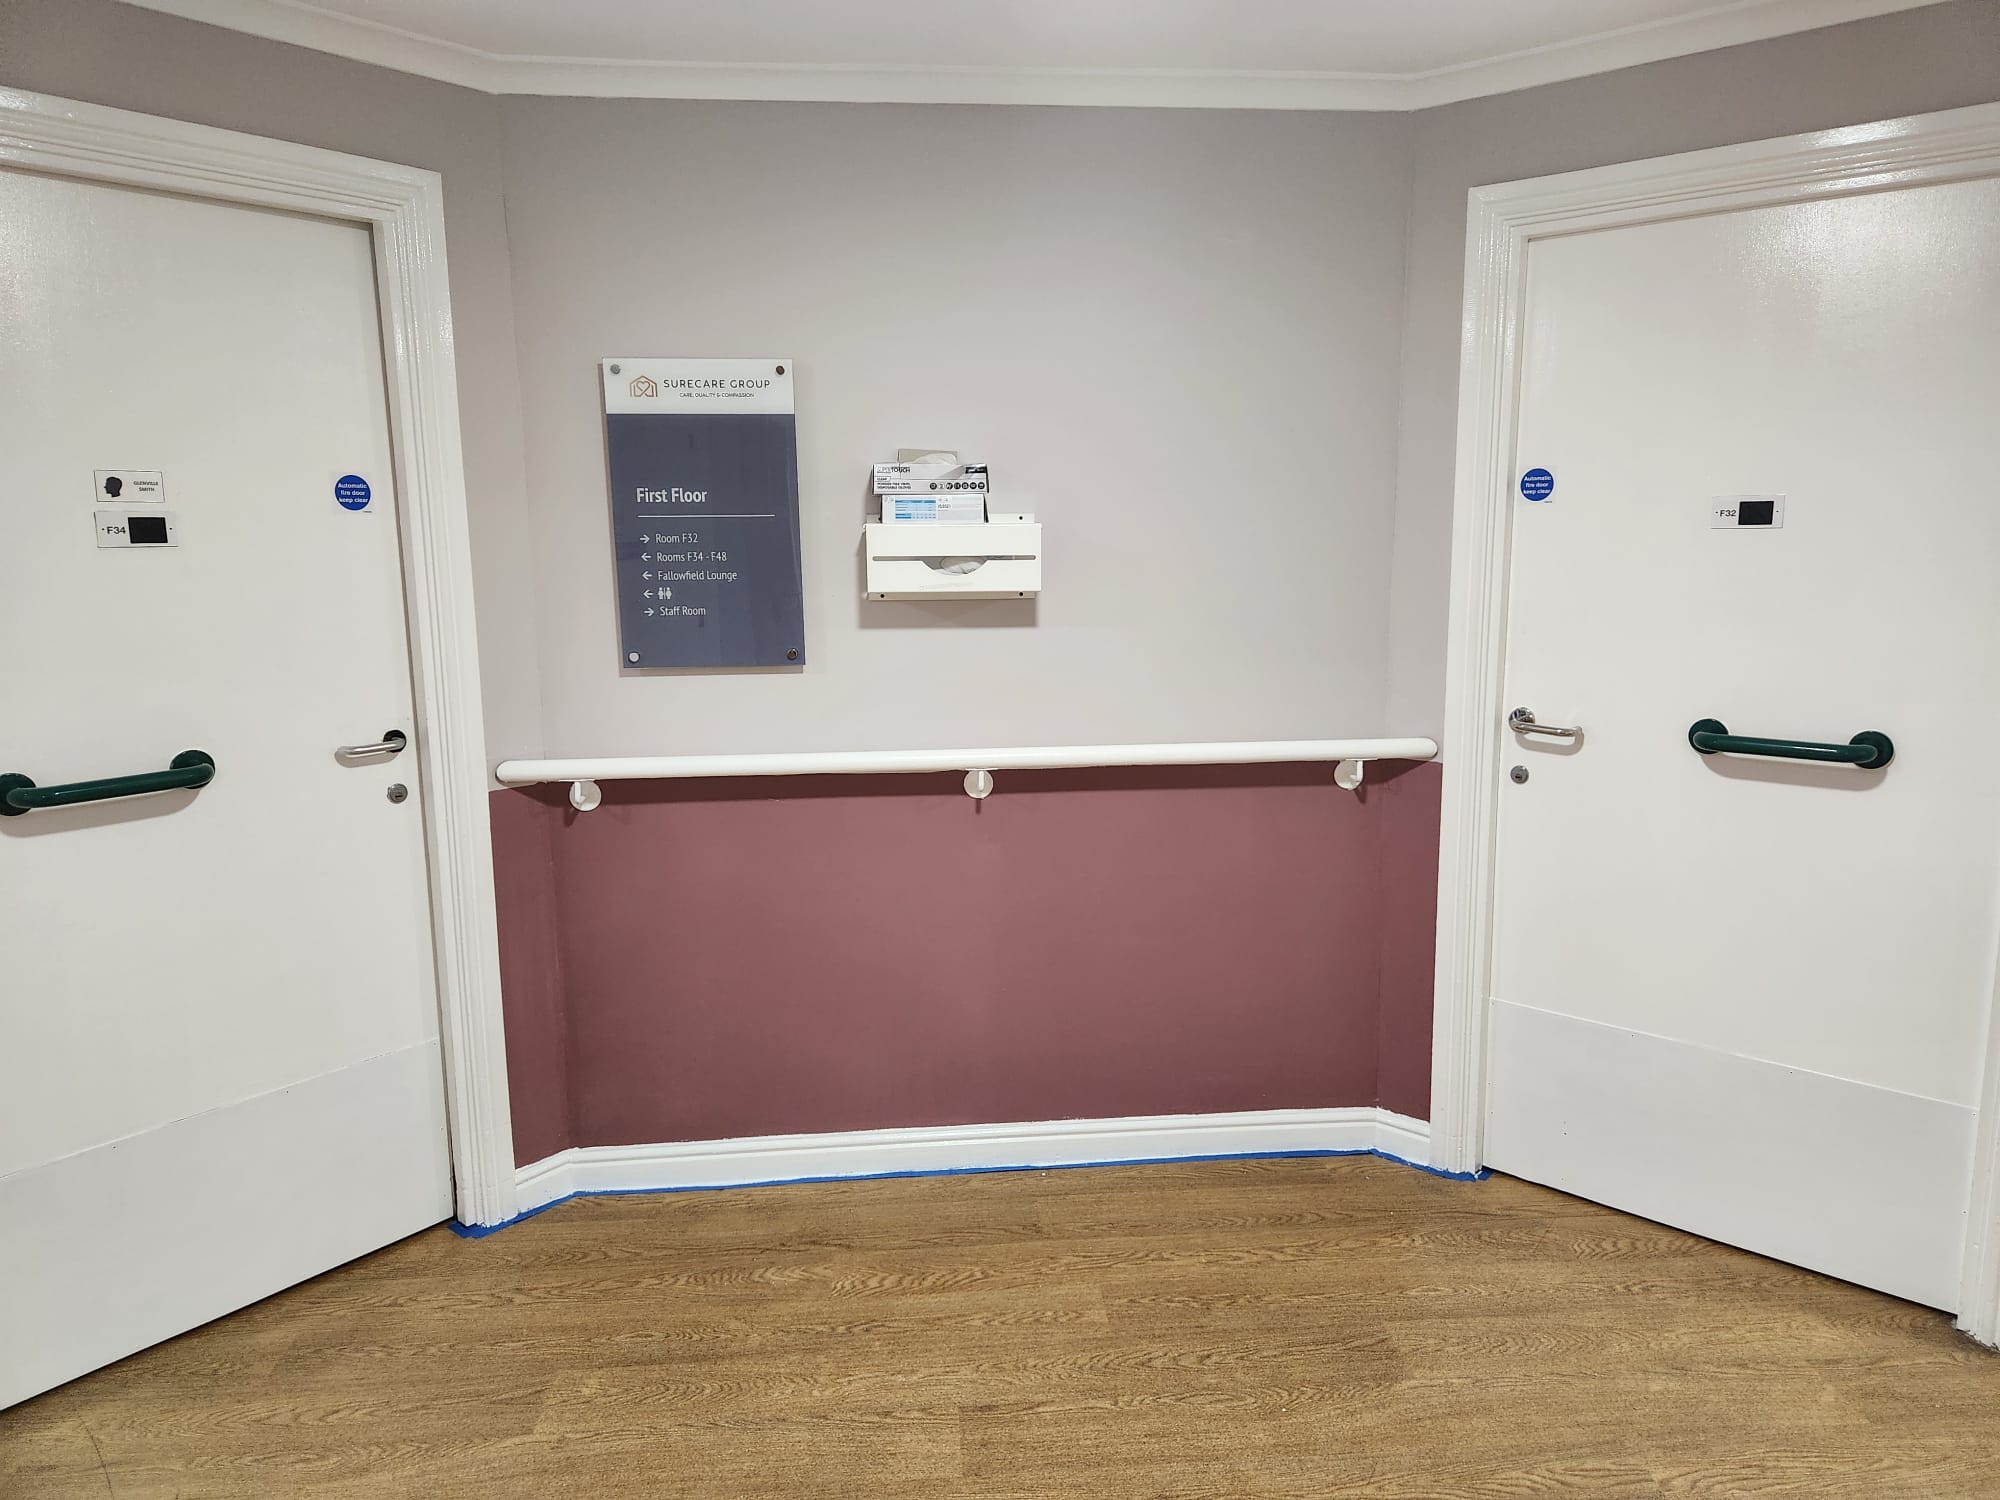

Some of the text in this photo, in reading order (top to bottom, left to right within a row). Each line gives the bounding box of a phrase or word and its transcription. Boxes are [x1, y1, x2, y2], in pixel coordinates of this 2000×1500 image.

[663, 379, 771, 389] SURECARE GROUP
[636, 487, 708, 503] First Floor
[1719, 509, 1737, 517] F32
[106, 526, 126, 535] F34
[655, 533, 699, 544] Room F32
[656, 552, 685, 562] Rooms
[687, 552, 703, 562] F34
[711, 551, 727, 562] F48
[658, 570, 738, 583] Fallowfield Lounge
[660, 606, 706, 616] Staff Room
